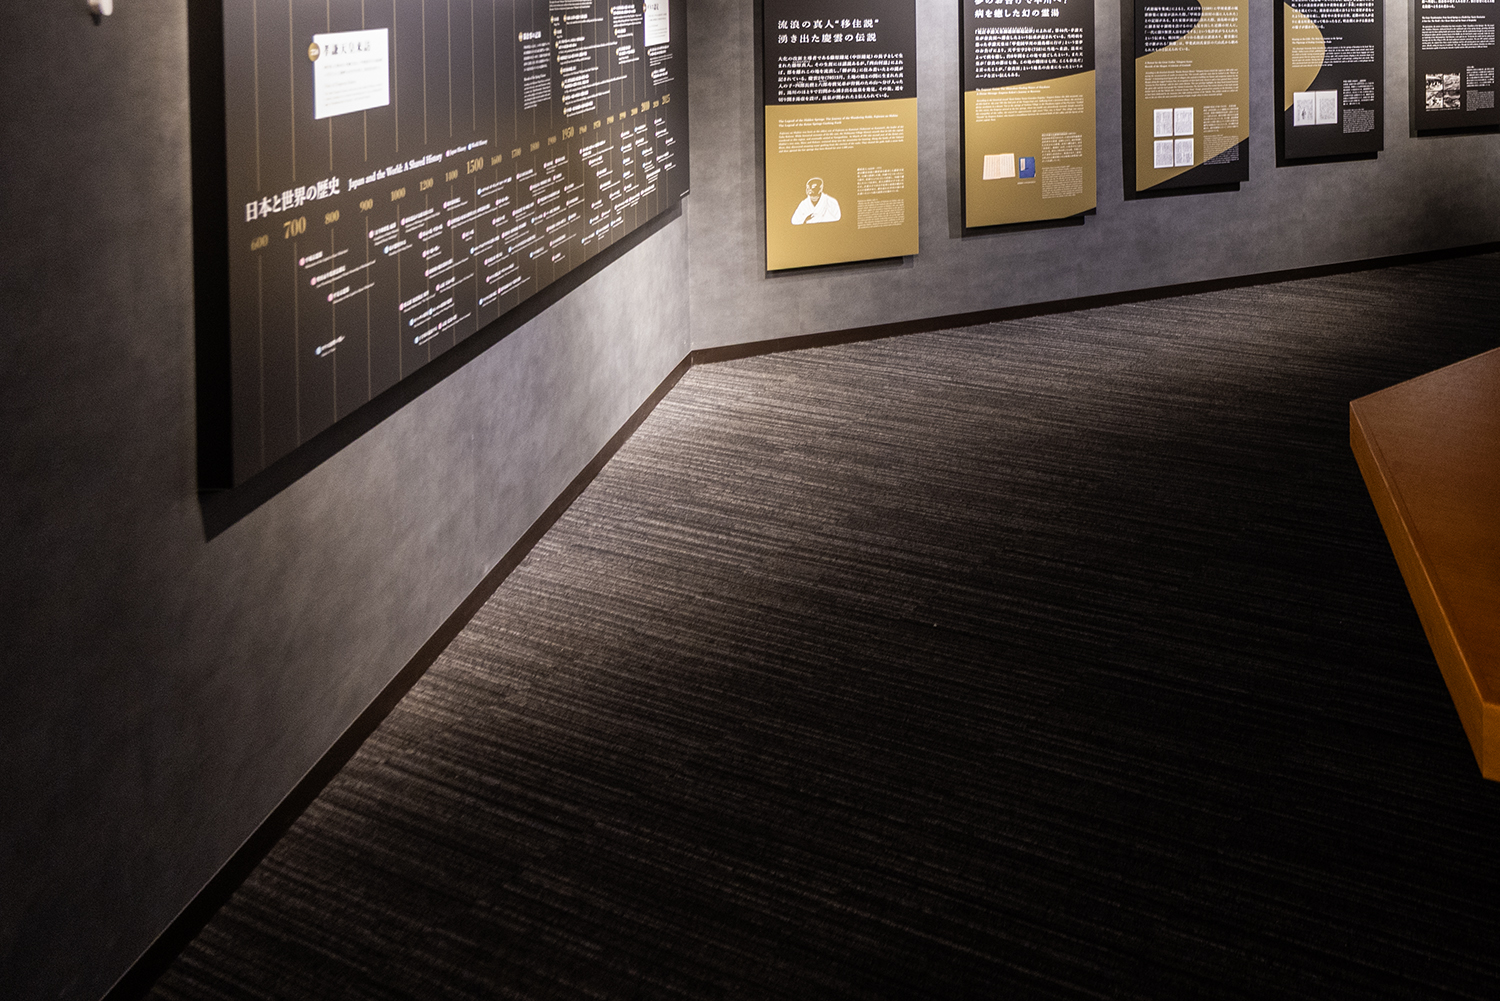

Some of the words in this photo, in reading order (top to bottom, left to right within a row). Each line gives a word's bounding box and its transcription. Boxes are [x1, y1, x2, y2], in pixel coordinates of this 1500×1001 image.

[778, 32, 877, 44] 湧き出た慶雲の伝説
[365, 171, 377, 184] and
[376, 169, 386, 180] the
[403, 161, 410, 172] A
[408, 156, 426, 170] Shared
[425, 153, 443, 165] History
[245, 176, 340, 222] 日本と世界の歴史
[250, 234, 268, 251] 600
[283, 216, 307, 240] 700
[324, 209, 340, 225] 800
[359, 198, 374, 214] 900
[390, 187, 406, 202] 1000
[419, 178, 434, 192] 1200
[466, 156, 484, 175] 1500
